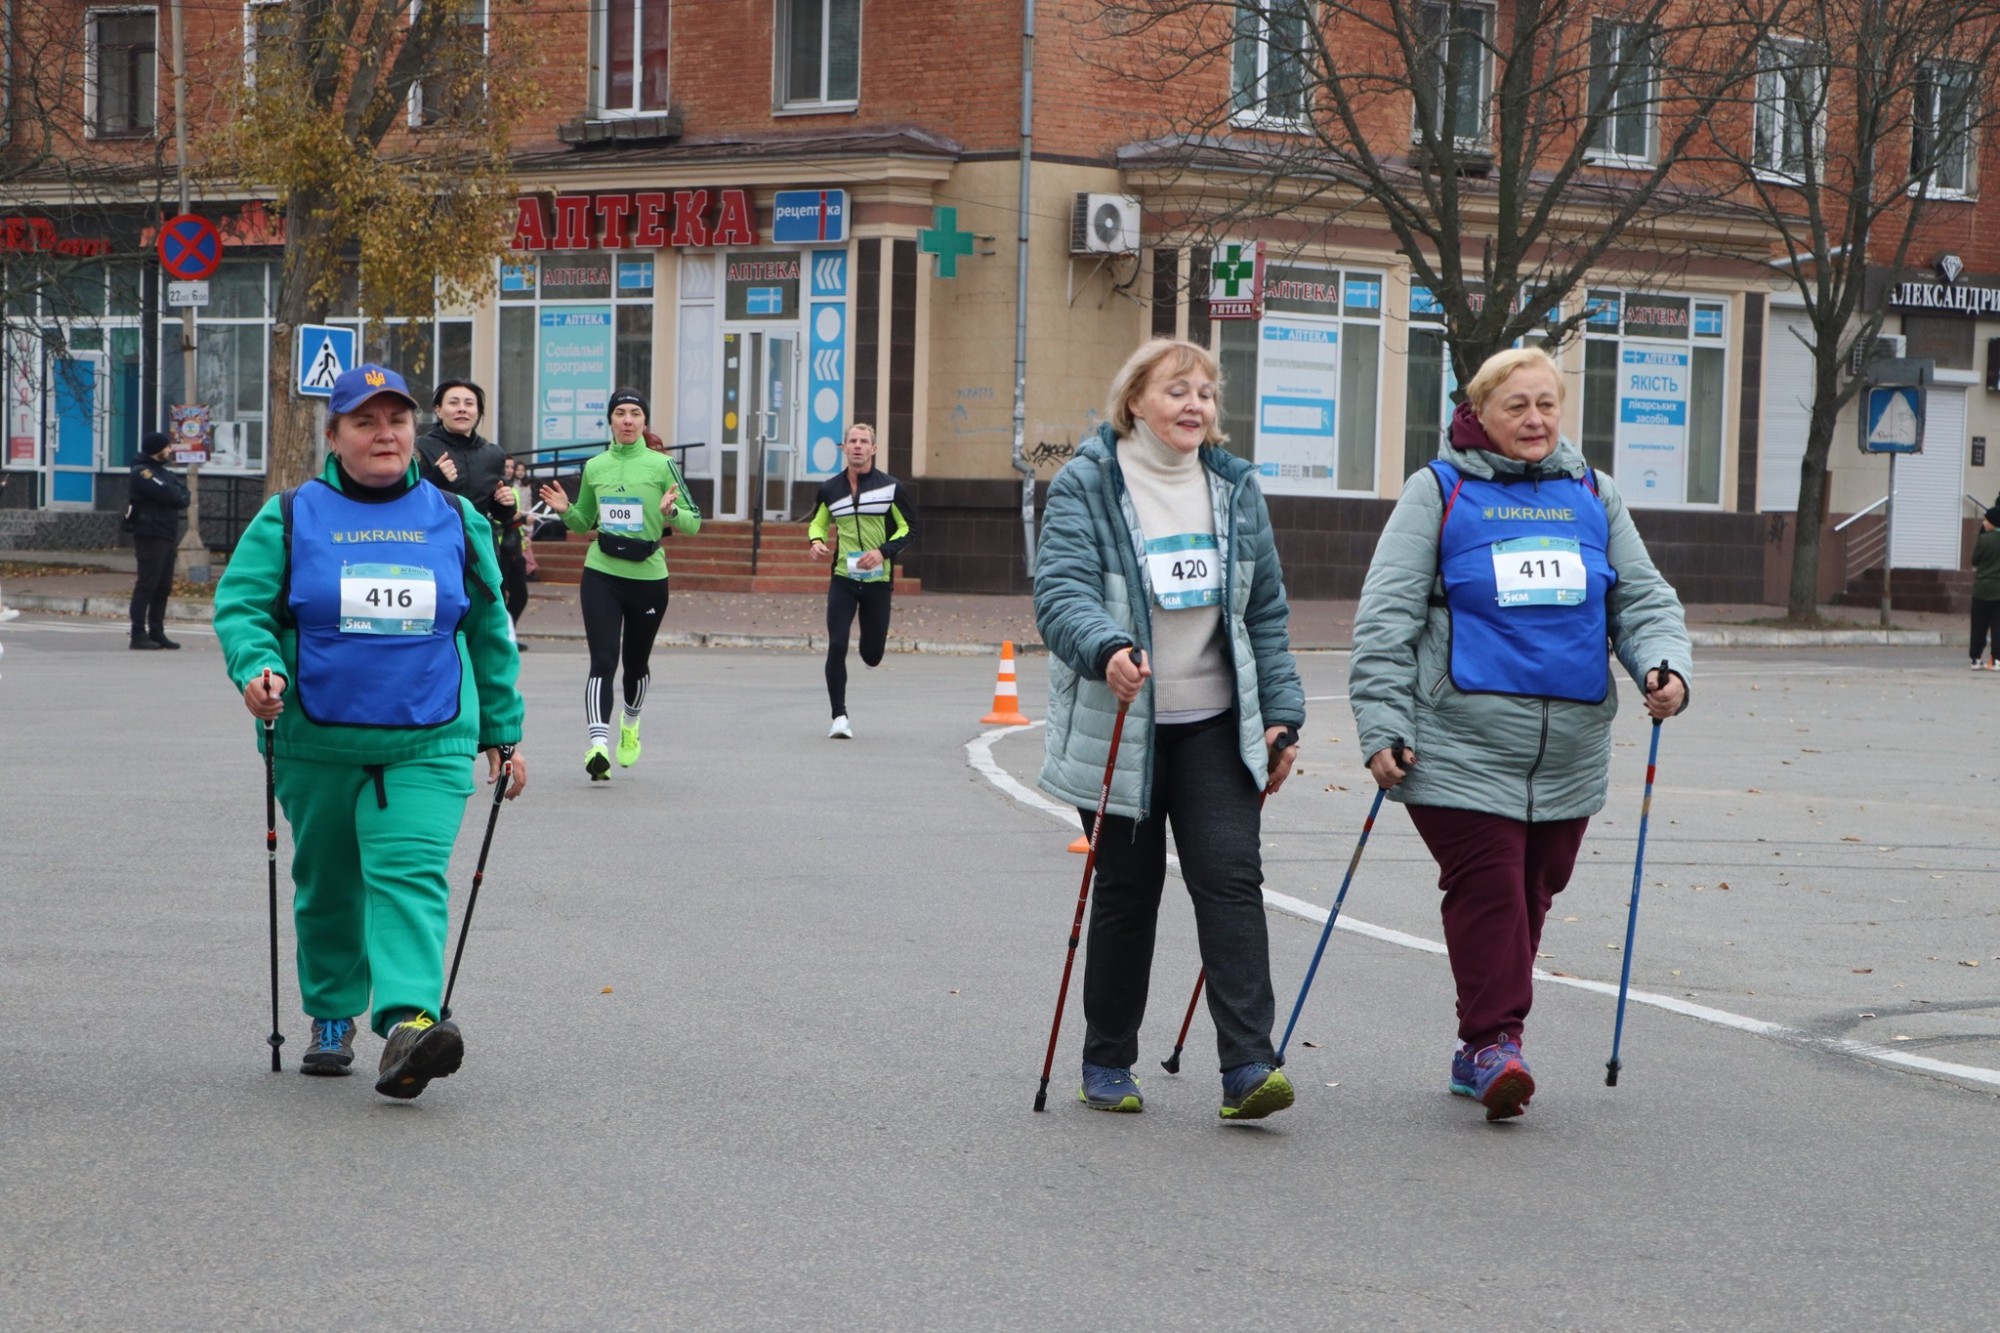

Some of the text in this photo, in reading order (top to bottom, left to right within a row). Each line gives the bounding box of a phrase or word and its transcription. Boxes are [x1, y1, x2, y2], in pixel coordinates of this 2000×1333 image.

[511, 189, 752, 250] АПТЕКА
[543, 267, 610, 286] АПТЕКА
[727, 261, 801, 281] АПТЕКА
[1266, 280, 1338, 303] АПТЕКА
[1210, 303, 1252, 316] АПТЕКА
[1625, 306, 1689, 326] АПТЕКА
[564, 314, 605, 325] АПТЕКА
[1288, 329, 1329, 342] АПТЕКА
[545, 342, 604, 358] Соціальні
[1643, 352, 1680, 366] АПТЕКА
[545, 361, 604, 376] програми
[1630, 374, 1679, 392] ЯКІСТЬ
[1628, 399, 1677, 412] лікарських
[1636, 413, 1670, 425] засобів
[609, 509, 631, 520] 008
[1497, 506, 1575, 521] UKRAINE
[347, 529, 426, 543] UKRAINE
[1171, 559, 1208, 580] 420
[1519, 559, 1561, 578] 411
[365, 588, 413, 608] 416
